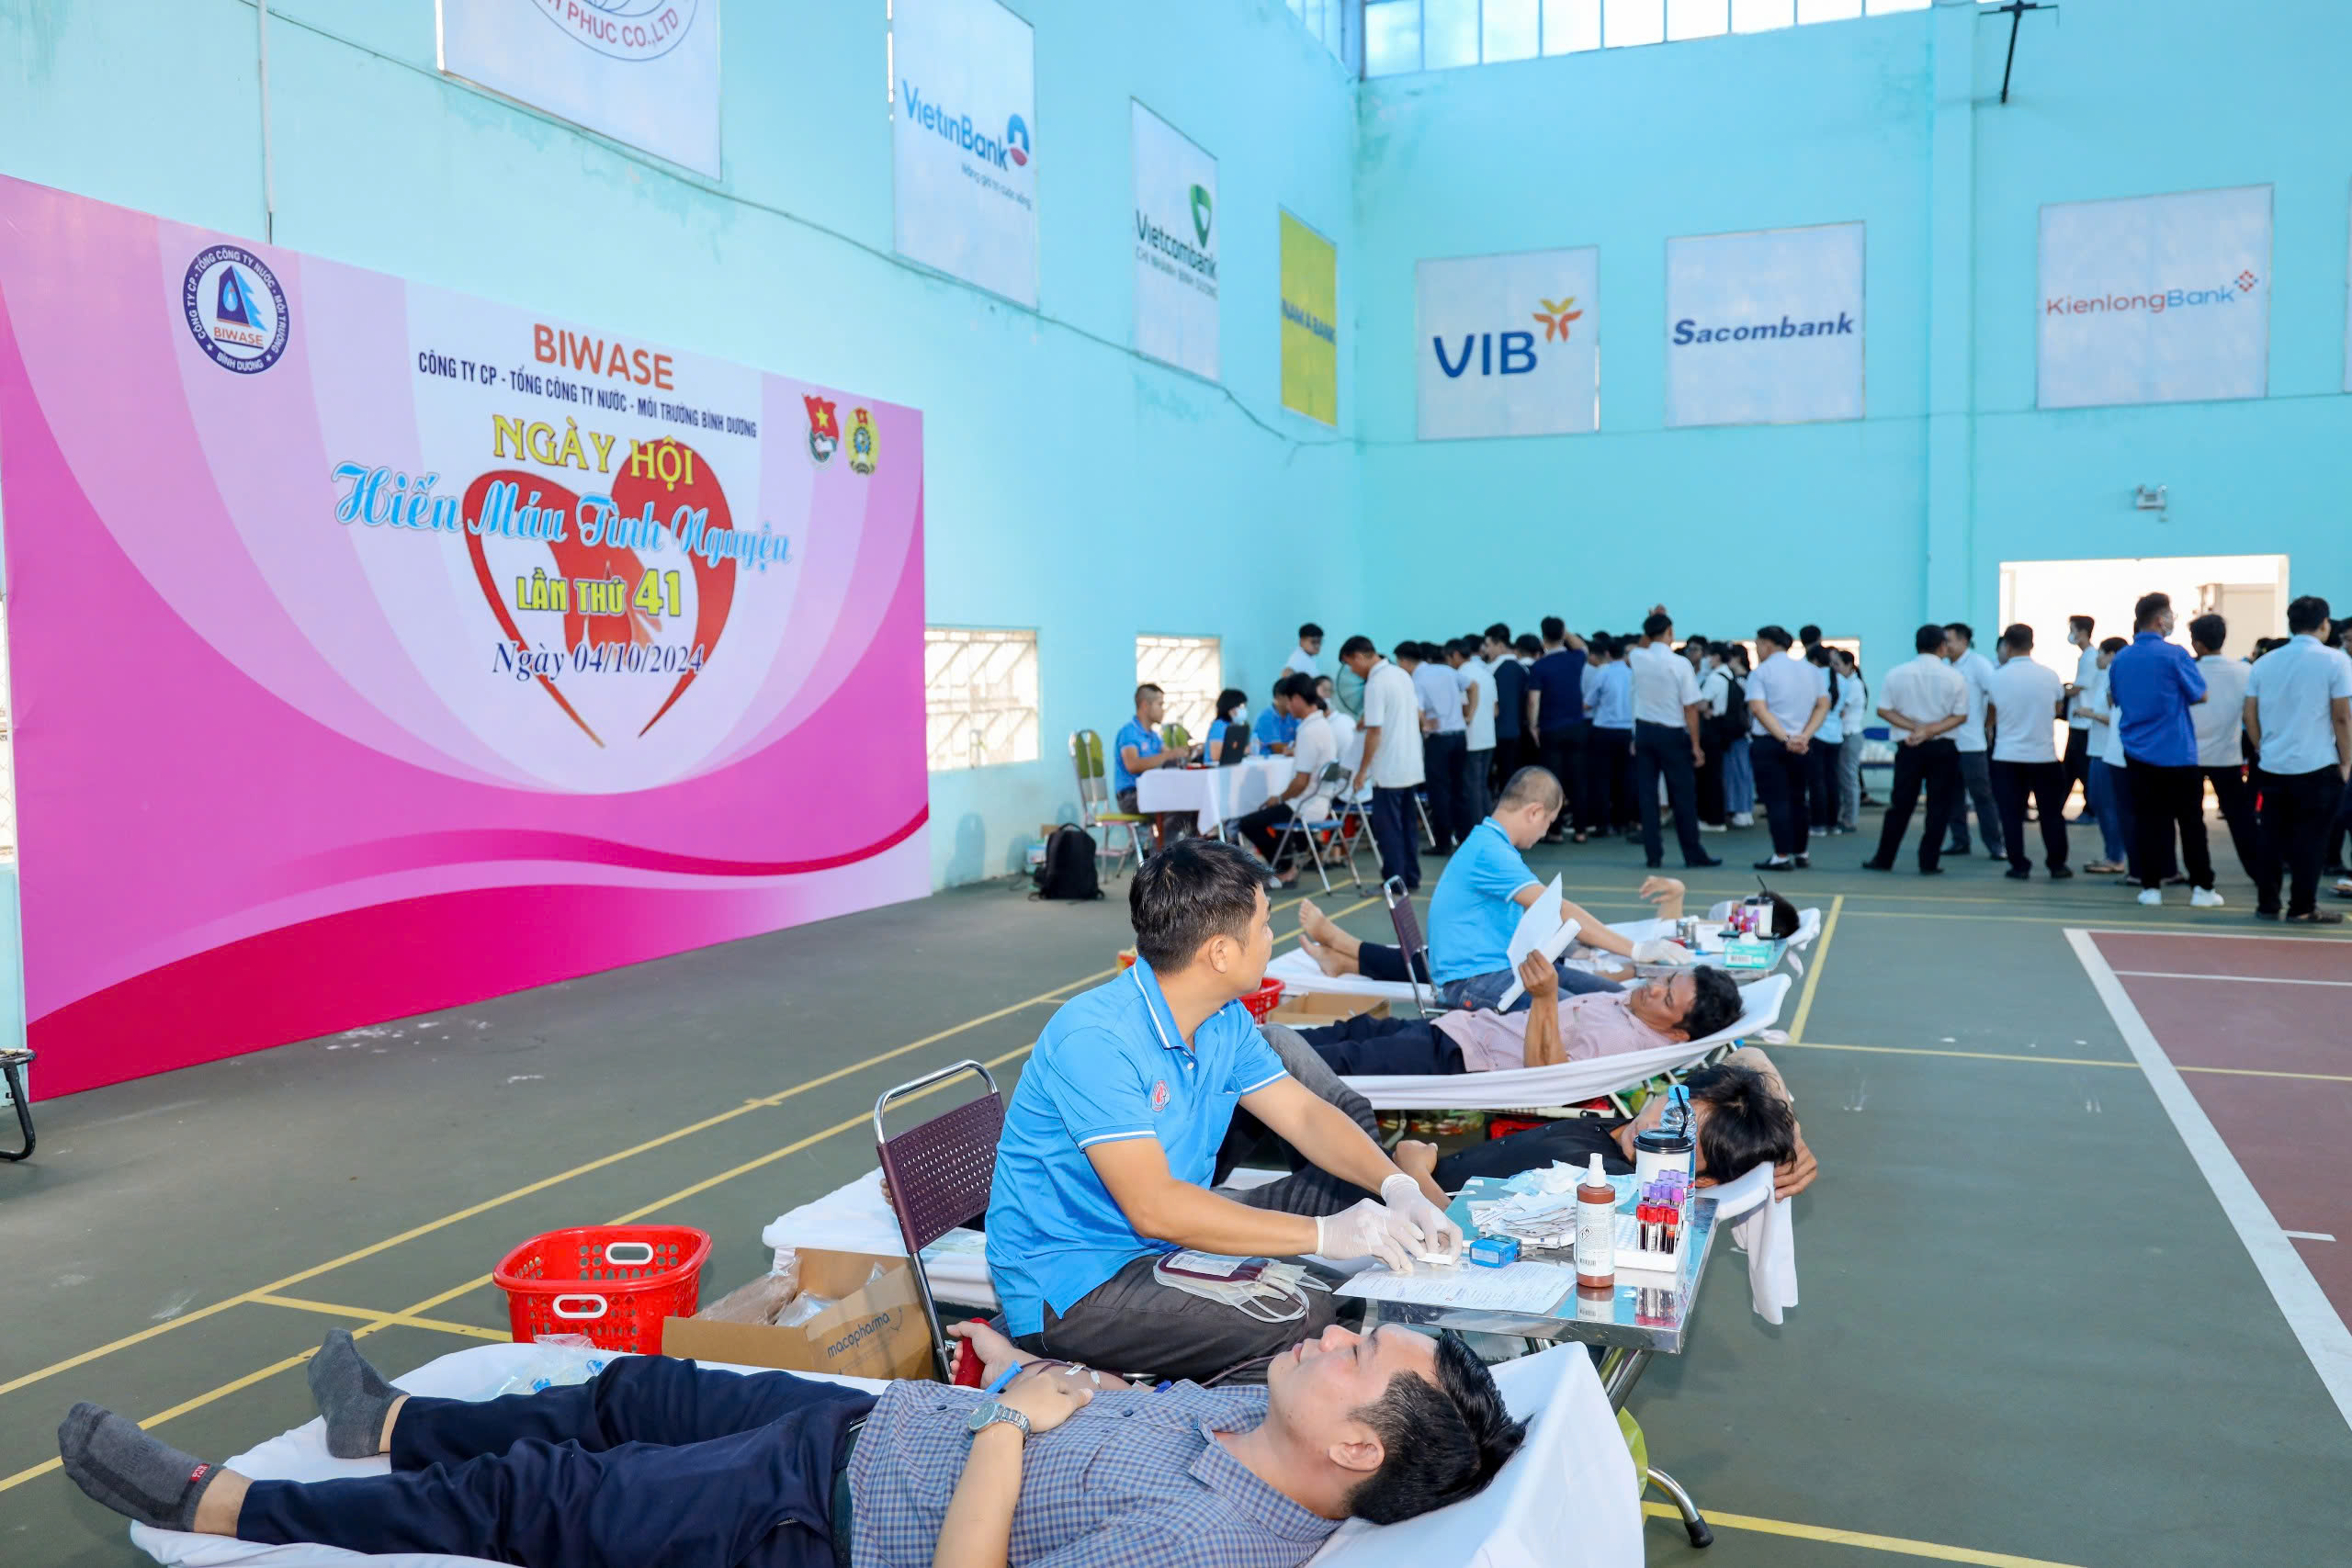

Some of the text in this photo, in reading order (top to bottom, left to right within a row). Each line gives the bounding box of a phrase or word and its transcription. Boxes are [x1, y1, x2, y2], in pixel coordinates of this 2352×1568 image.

[567, 1, 617, 44] PHUC
[902, 79, 1009, 173] VietinBank
[1136, 209, 1217, 281] Vietcombank
[2046, 286, 2235, 316] KienlongBank
[213, 326, 265, 346] BIWASE
[1672, 310, 1855, 345] Sacombank
[534, 323, 674, 391] BIWASE
[1433, 332, 1538, 378] VIB
[419, 350, 457, 378] CÔNG
[460, 360, 476, 382] TY
[481, 365, 497, 386] CP
[510, 365, 542, 396] TỔNG
[546, 376, 578, 402] CÔNG
[581, 386, 594, 407] TY
[597, 389, 627, 412] NƯỚC
[492, 414, 694, 491] NGÀY HỘI
[331, 461, 792, 572] Hiến Máu Tình Nguyện
[515, 567, 682, 617] LẦN THỨ 41
[492, 642, 706, 682] Ngày 04/10/2024
[827, 1313, 890, 1359] macopharma
